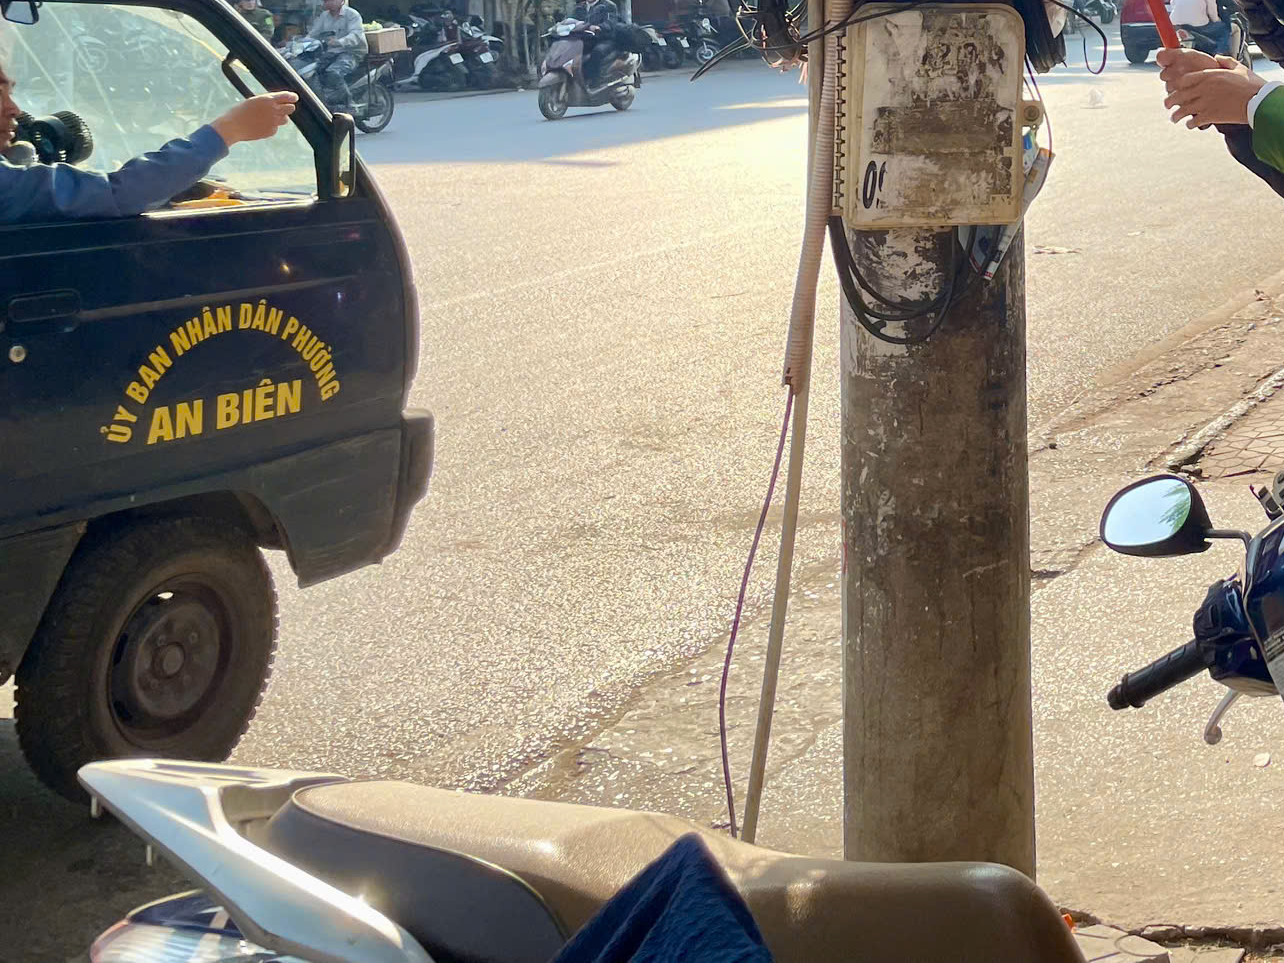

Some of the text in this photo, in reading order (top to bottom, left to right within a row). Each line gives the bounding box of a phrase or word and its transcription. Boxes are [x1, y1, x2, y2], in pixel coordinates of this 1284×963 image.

[100, 299, 340, 444] ỦY BAN NHÂN DÂN PHƯỜNG
[146, 378, 303, 445] AN BIÊN
